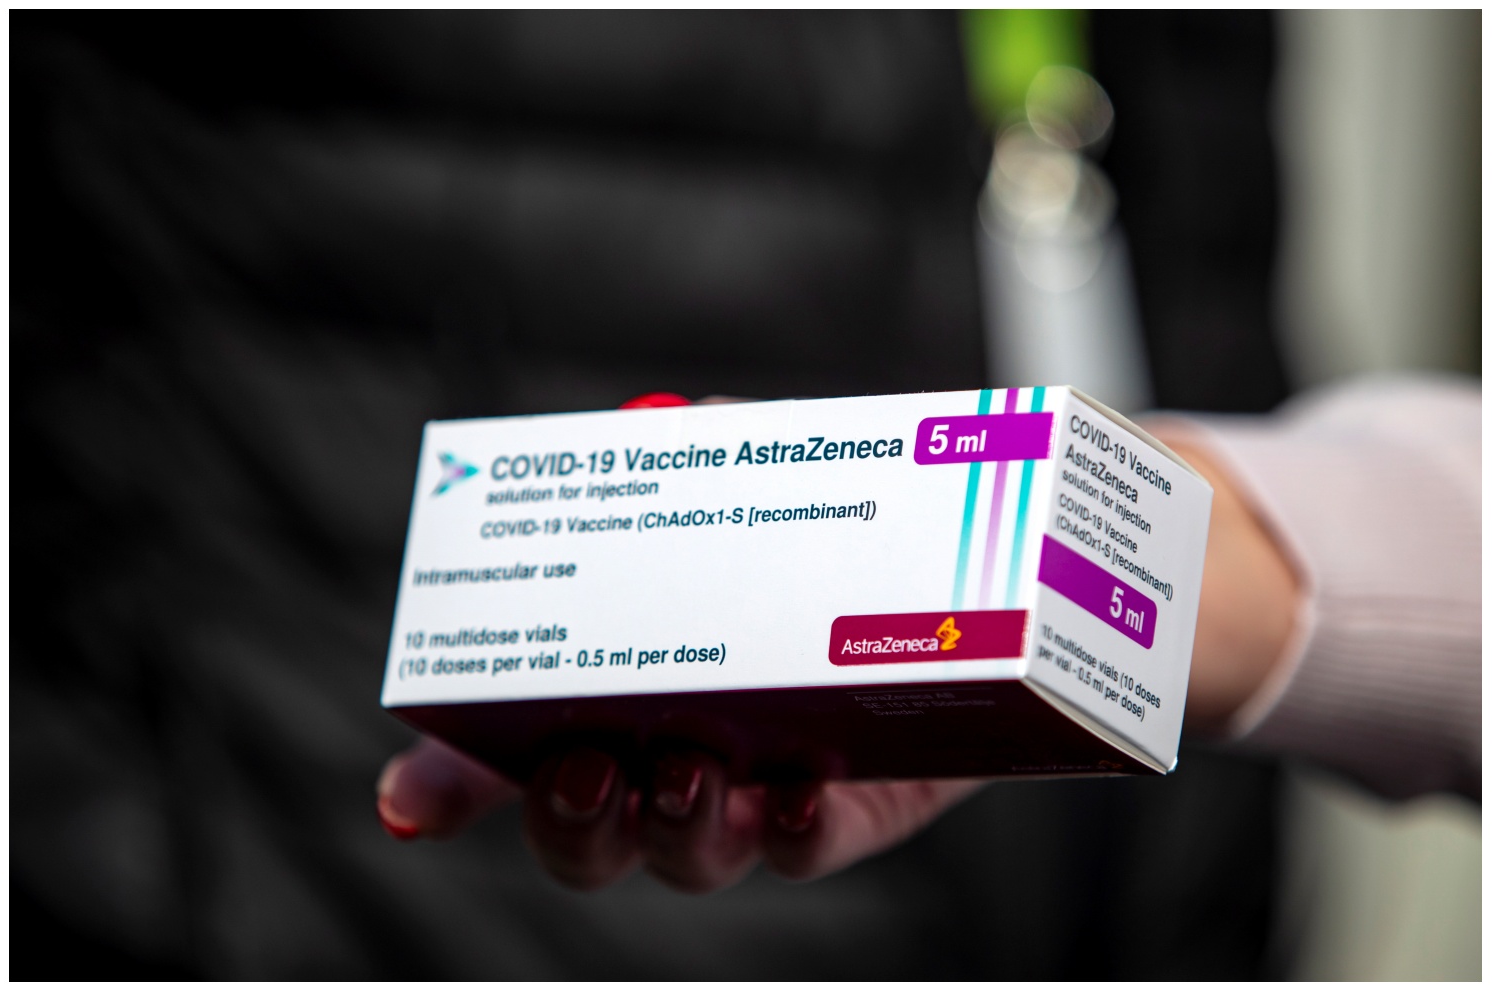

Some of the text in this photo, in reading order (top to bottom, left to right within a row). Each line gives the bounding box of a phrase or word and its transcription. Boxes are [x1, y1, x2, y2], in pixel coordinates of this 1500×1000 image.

[490, 437, 904, 481] COVID-19 Vaccine AstraZeneca
[928, 424, 987, 455] 5 ml
[1070, 414, 1172, 496] COVID-19 Vaccine
[485, 480, 659, 506] solution for injection
[1065, 443, 1139, 503] AstraZeneca
[479, 500, 877, 540] COVID-19 Vaccine (ChAdOx1-S [recombinant])
[1060, 493, 1138, 554] COVID-19 Vaccine
[1062, 469, 1152, 534] solution for injection
[543, 562, 577, 579] use
[1056, 514, 1174, 602] (ChAdOx1-S [recombinant])
[1109, 585, 1145, 634] 5 ml
[405, 623, 568, 650] 10 multidose vials
[841, 637, 939, 655] AstraZeneca
[399, 655, 426, 681] (10
[432, 652, 487, 676] doses
[491, 655, 522, 677] per
[528, 651, 560, 670] vial
[576, 649, 605, 668] 0.5
[609, 647, 632, 666] ml
[637, 647, 669, 670] per
[673, 643, 726, 666] dose)
[1037, 645, 1055, 660] per
[1056, 655, 1071, 673] vial
[1078, 666, 1092, 686] 0.5
[1093, 678, 1103, 694] ml
[1105, 686, 1120, 704] per
[1121, 695, 1145, 722] dose)
[1041, 623, 1161, 709] 10 multidose vials (10 doses
